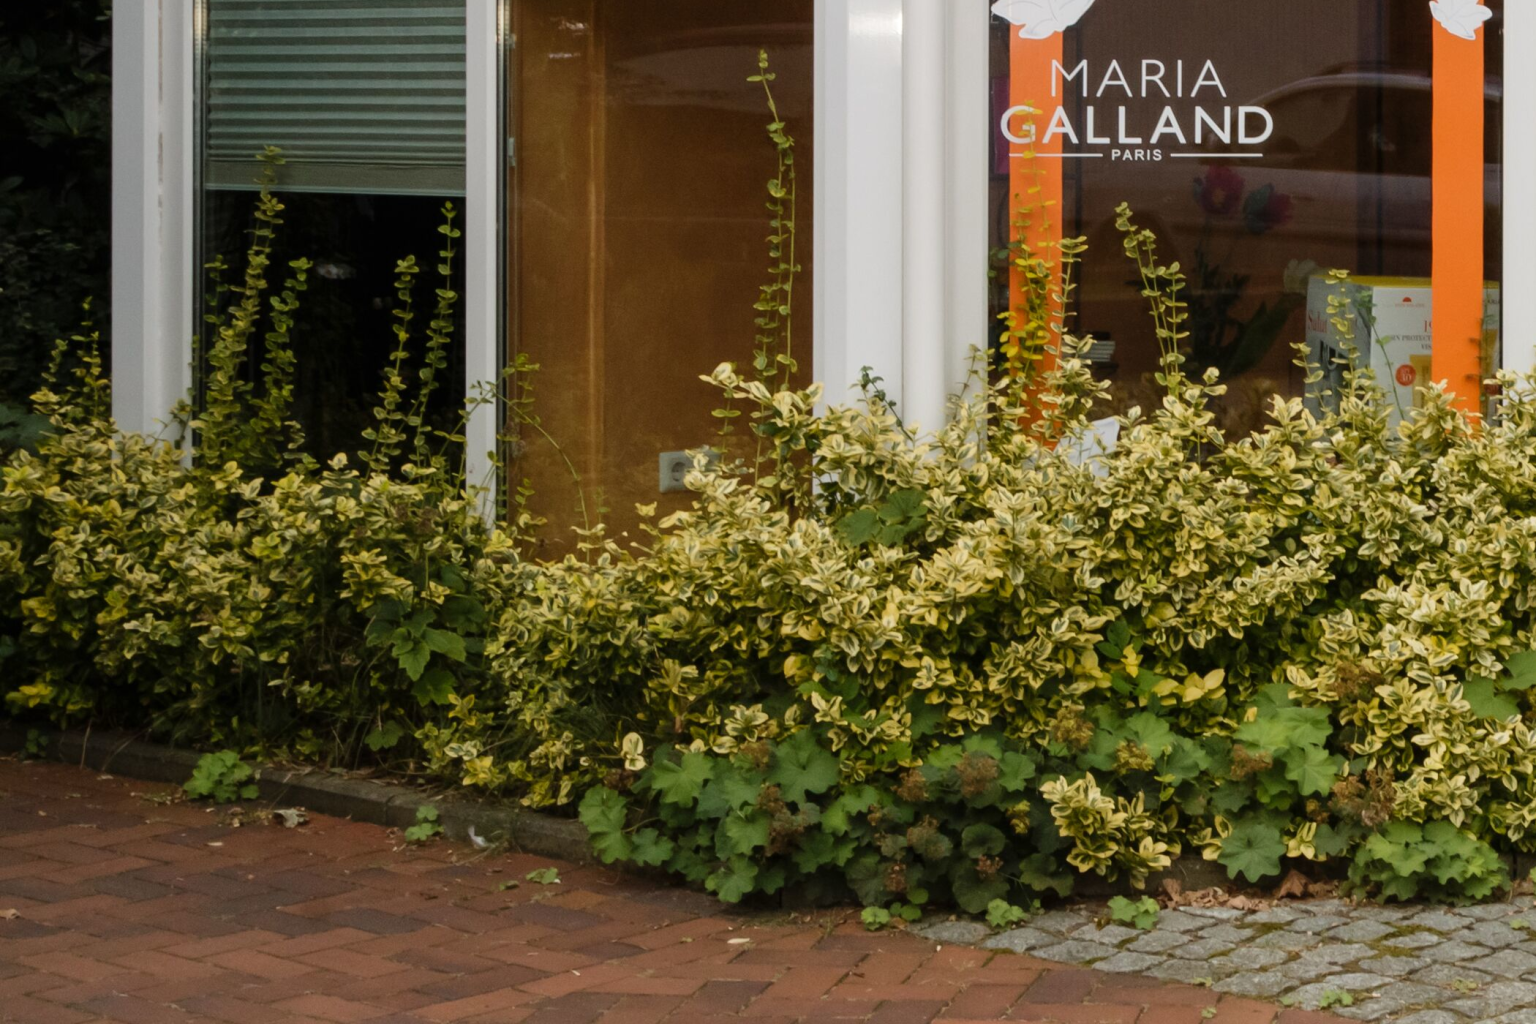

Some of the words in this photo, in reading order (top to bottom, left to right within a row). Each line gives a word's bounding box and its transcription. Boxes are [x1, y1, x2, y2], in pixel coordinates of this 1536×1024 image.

[1051, 59, 1227, 97] MARIA
[1000, 105, 1274, 144] GALLAND
[1111, 149, 1163, 161] PARIS
